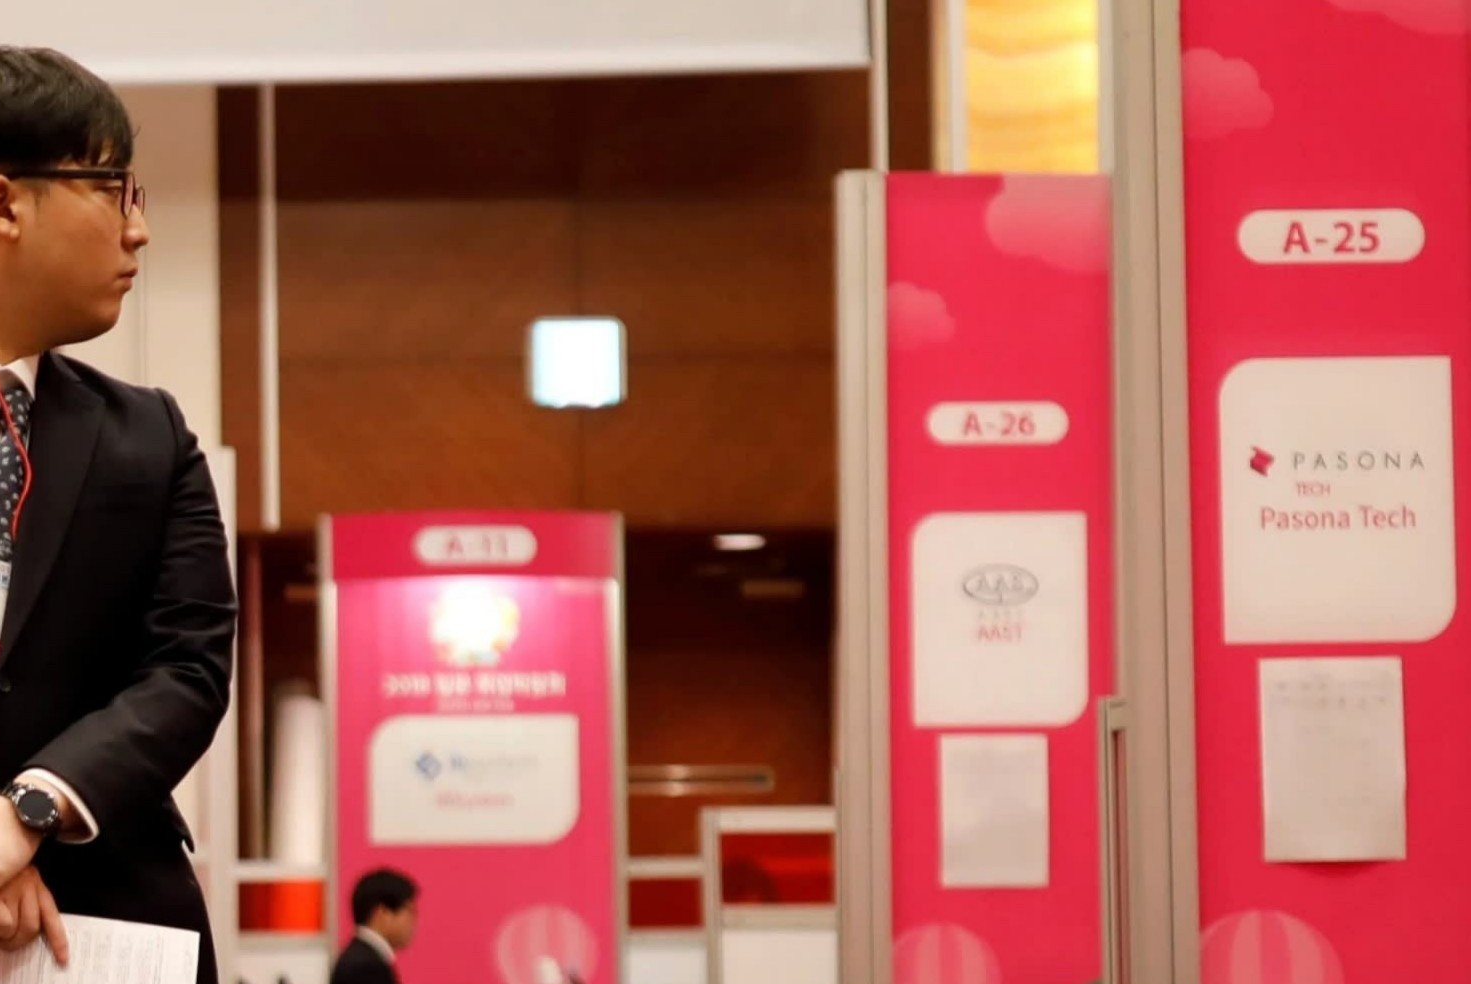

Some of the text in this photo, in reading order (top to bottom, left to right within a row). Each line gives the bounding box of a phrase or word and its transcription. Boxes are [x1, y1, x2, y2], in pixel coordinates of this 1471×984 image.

[1282, 220, 1381, 256] A-25
[961, 411, 1036, 438] A-26
[1292, 451, 1426, 471] PASONA
[1260, 502, 1417, 530] Pasona Tech
